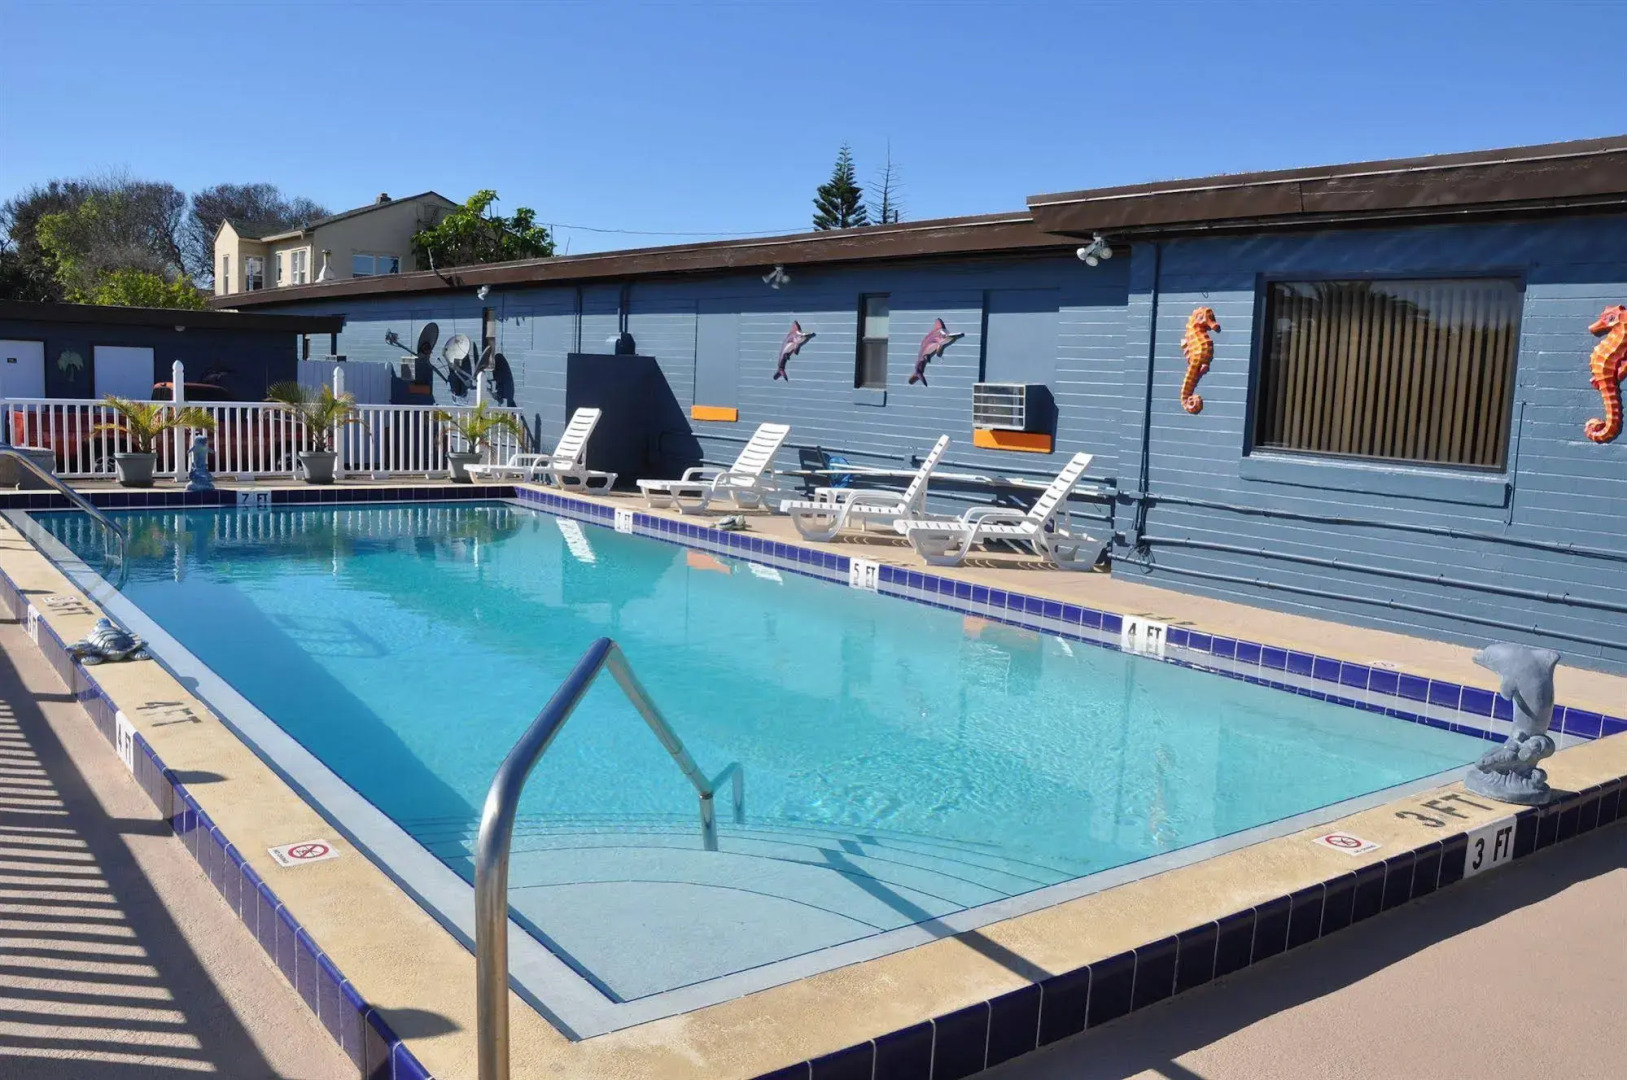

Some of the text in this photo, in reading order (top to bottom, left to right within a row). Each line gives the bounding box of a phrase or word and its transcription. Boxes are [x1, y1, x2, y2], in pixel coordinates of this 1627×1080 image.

[241, 493, 269, 504] 7 FT
[853, 562, 876, 578] 5 FT
[1128, 622, 1162, 640] 4 FT
[136, 701, 184, 711] 4
[117, 723, 132, 767] 4 FT
[1395, 793, 1494, 828] 3 FT
[1472, 825, 1514, 870] 3 FT
